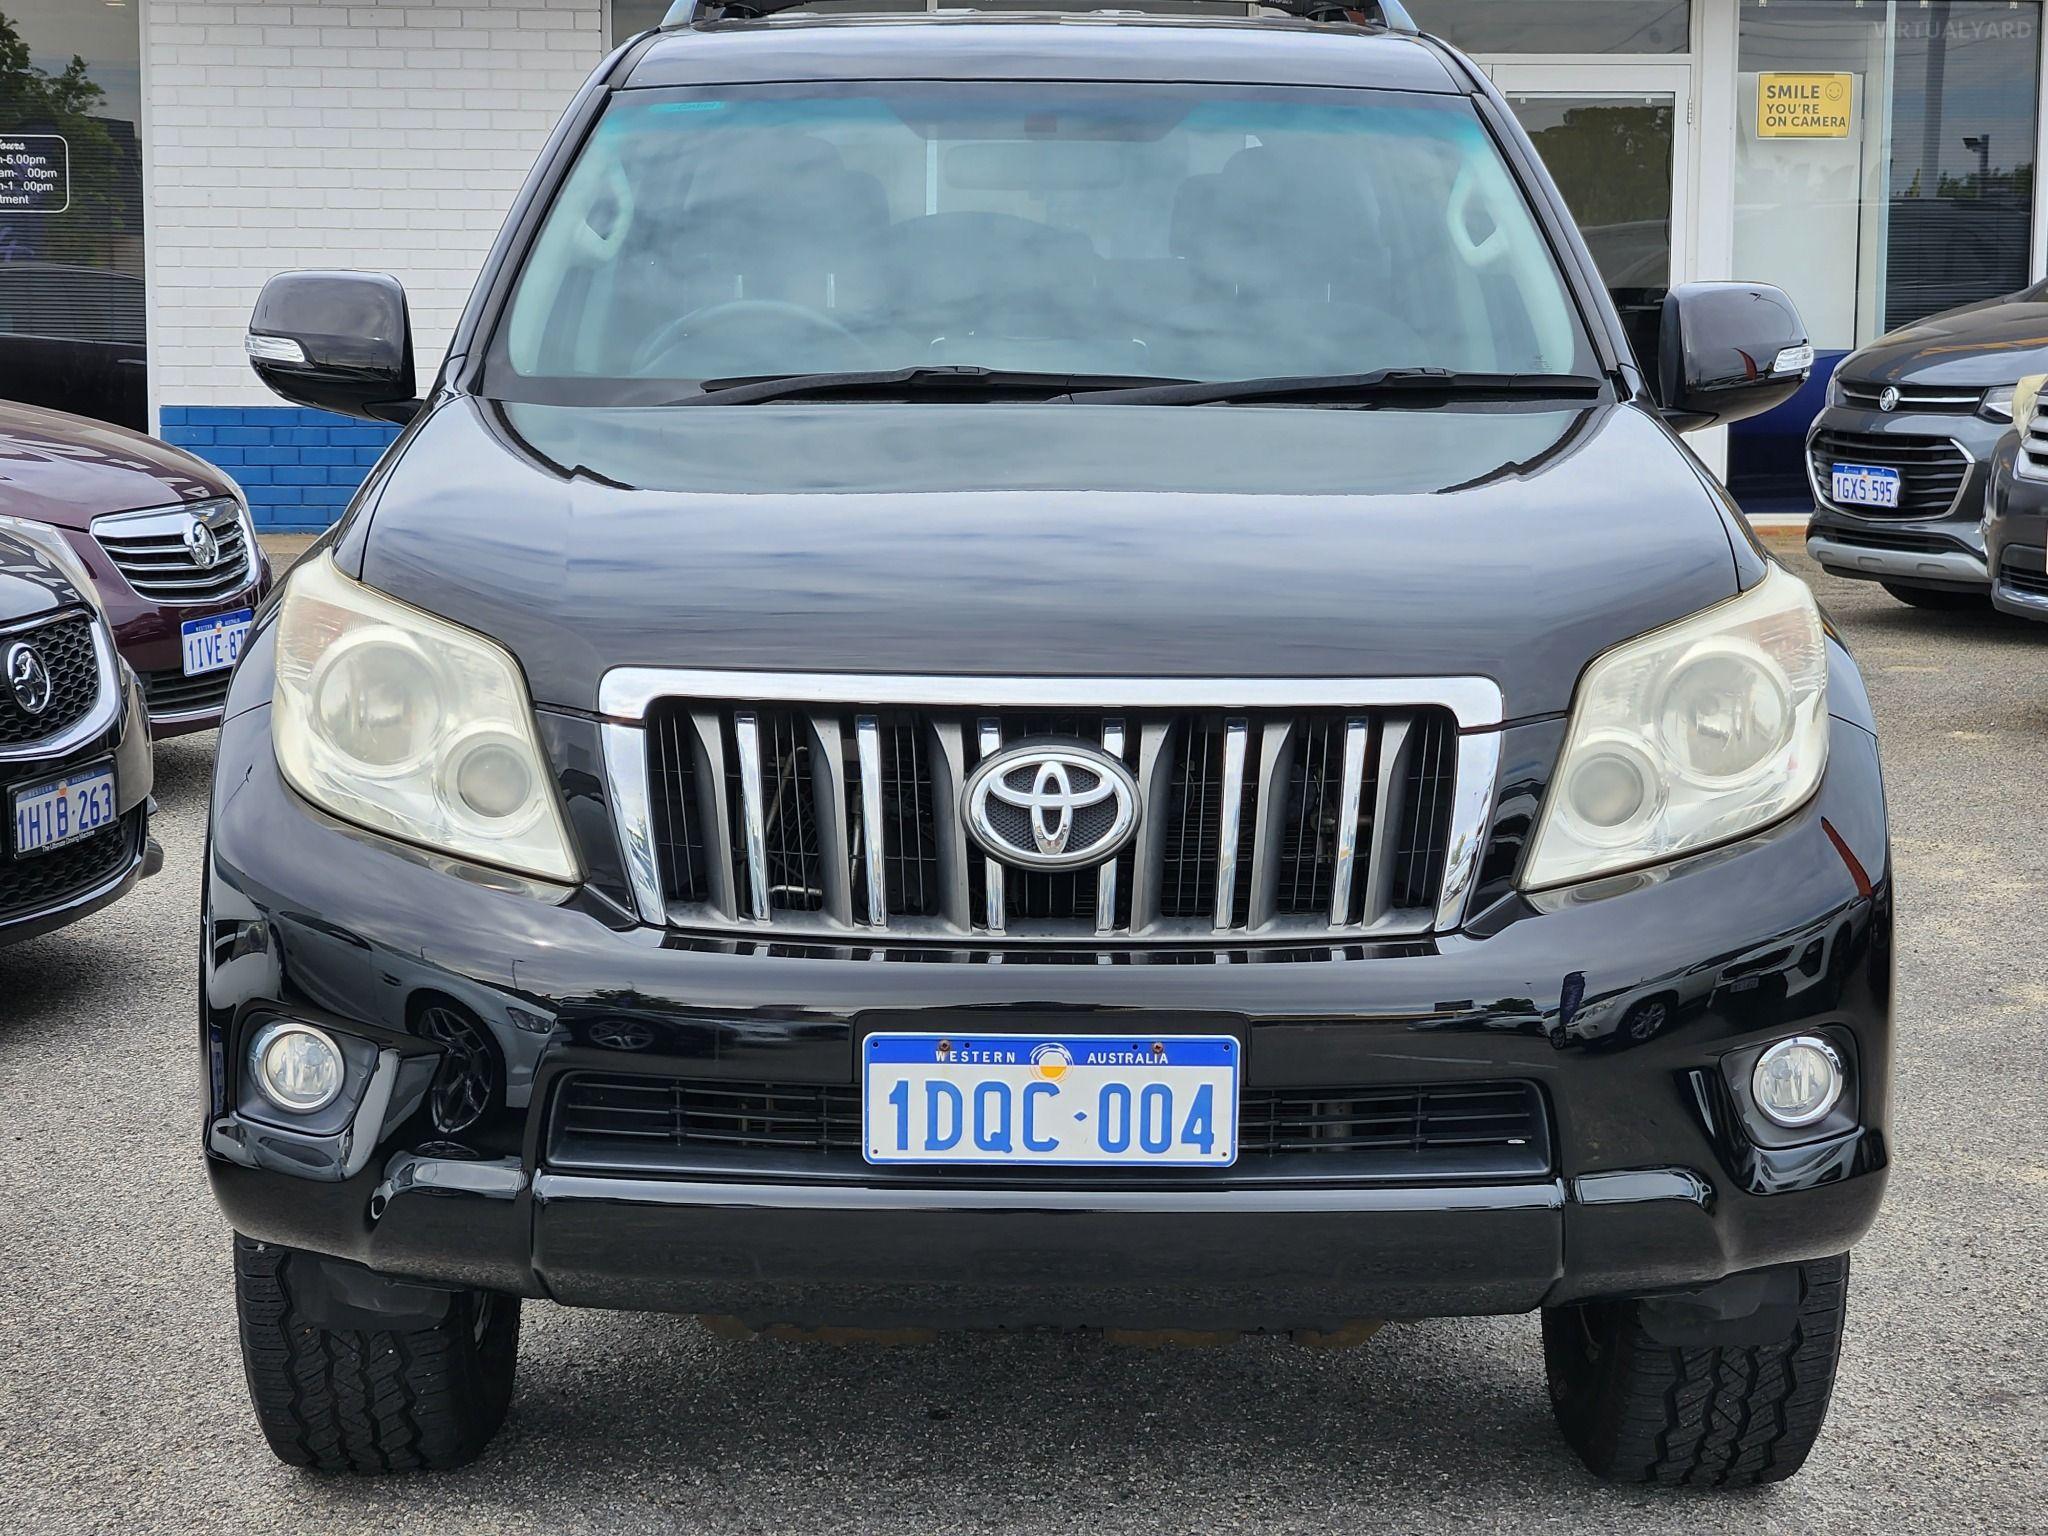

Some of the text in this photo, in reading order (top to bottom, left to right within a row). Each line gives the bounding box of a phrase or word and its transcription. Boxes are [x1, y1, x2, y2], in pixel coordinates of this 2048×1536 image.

[1766, 85, 1820, 99] SMILE
[1766, 104, 1819, 114] YOU'RE
[1766, 116, 1846, 127] ON CAMERA
[0, 139, 26, 150] ours
[935, 1051, 1168, 1064] WESTERN AUSTRALIA
